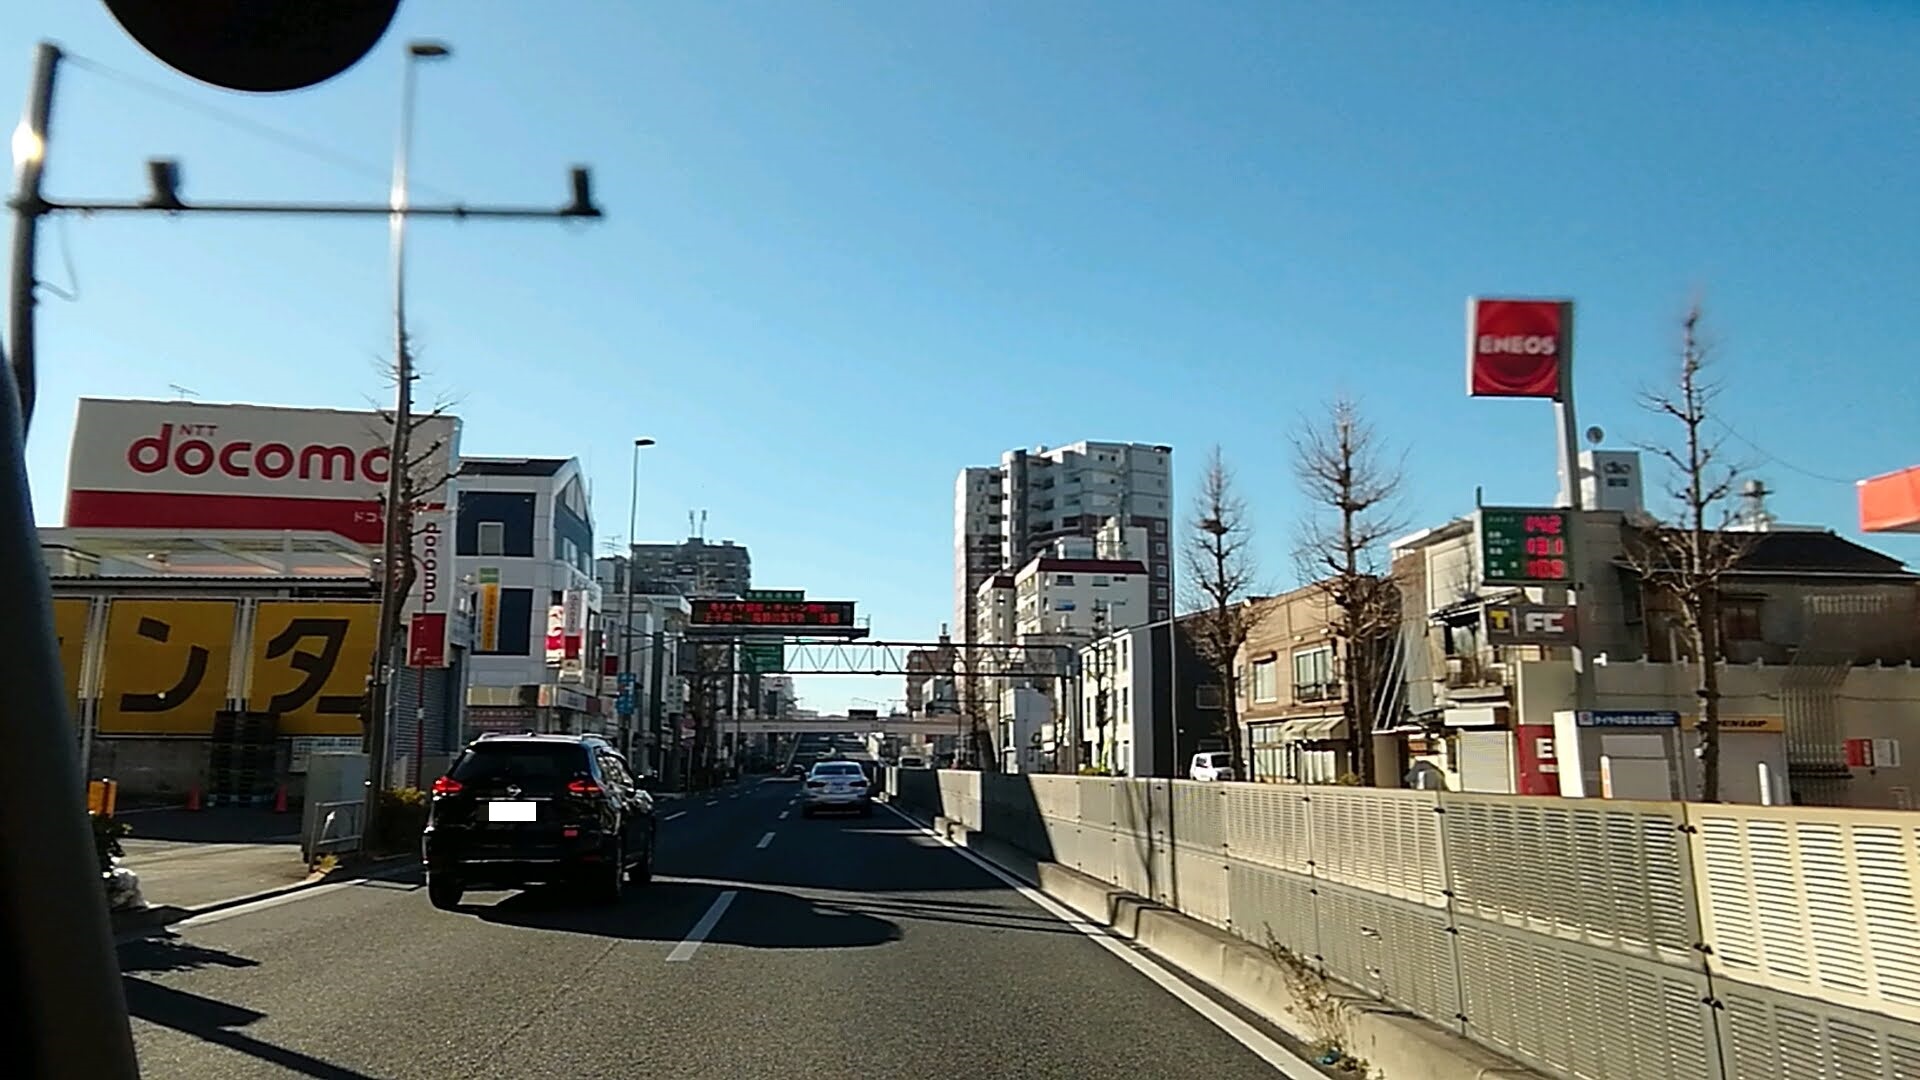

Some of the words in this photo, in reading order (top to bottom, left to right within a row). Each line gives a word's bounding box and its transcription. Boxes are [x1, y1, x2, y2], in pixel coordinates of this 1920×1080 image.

[1478, 335, 1556, 355] ENEOS
[179, 423, 220, 437] NTT
[424, 522, 442, 603] docomo
